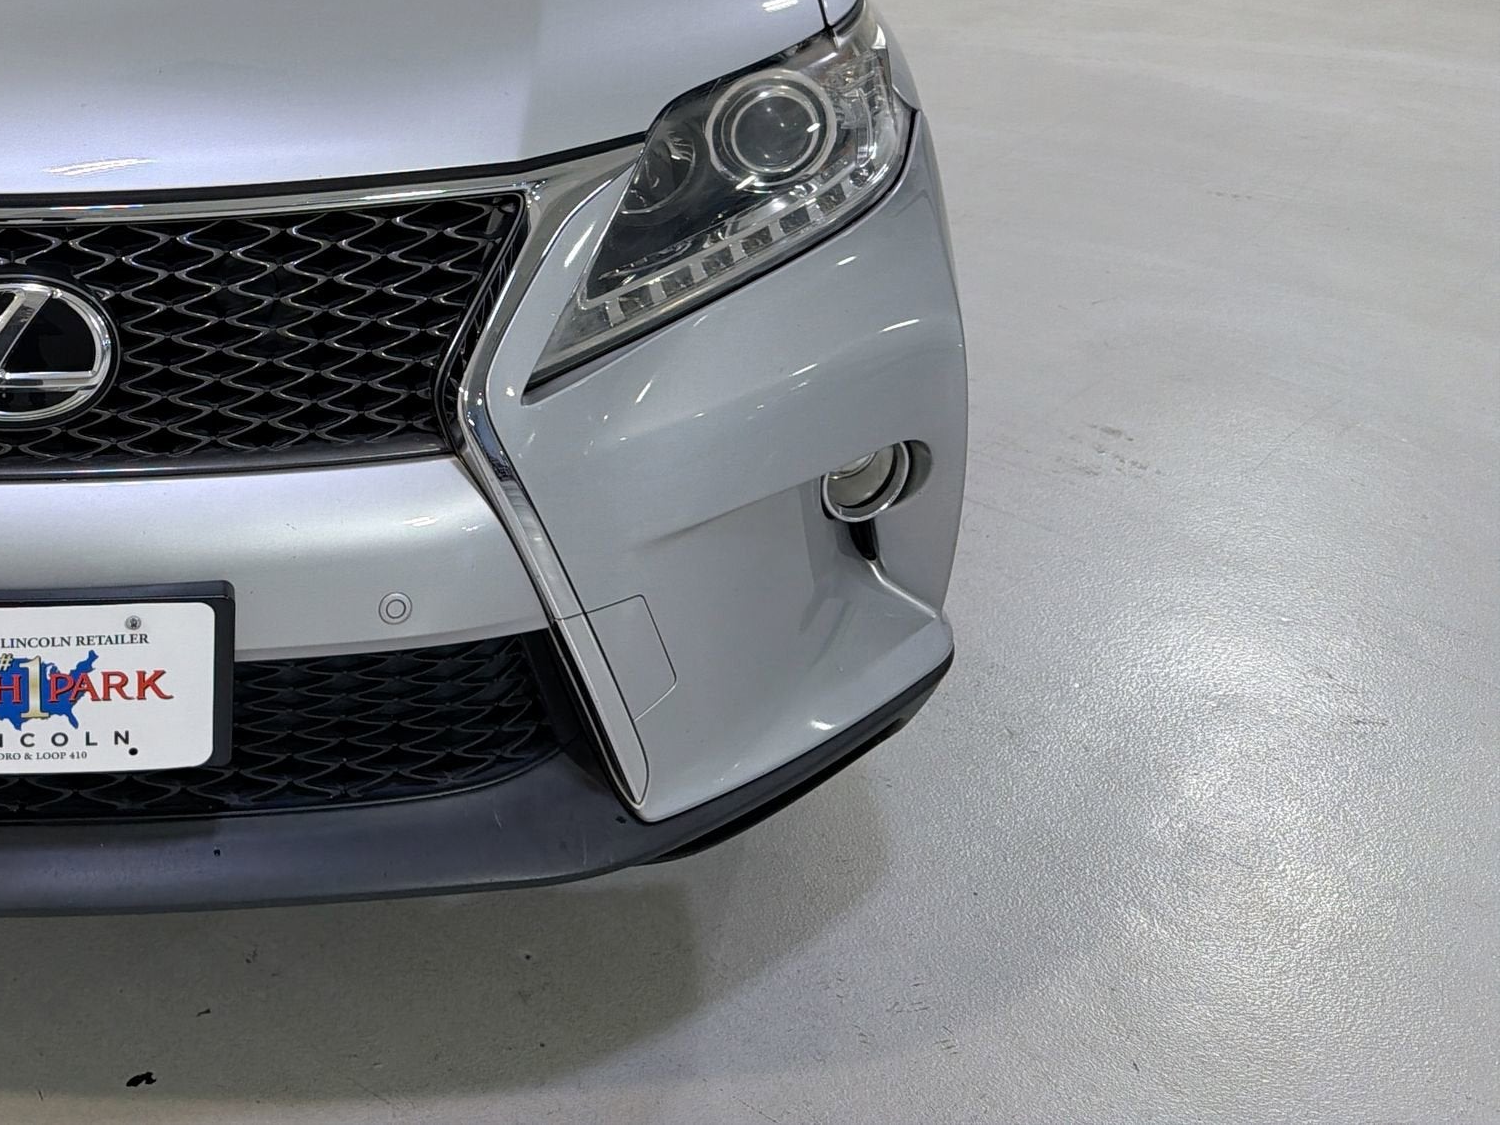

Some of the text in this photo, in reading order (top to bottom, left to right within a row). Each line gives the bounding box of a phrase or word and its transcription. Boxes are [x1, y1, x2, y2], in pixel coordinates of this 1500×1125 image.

[0, 636, 72, 649] LINCOLN
[76, 633, 150, 646] RETAILER
[49, 669, 174, 704] PARK
[24, 752, 33, 761] &
[36, 751, 67, 761] LOOP
[69, 751, 88, 760] 410
